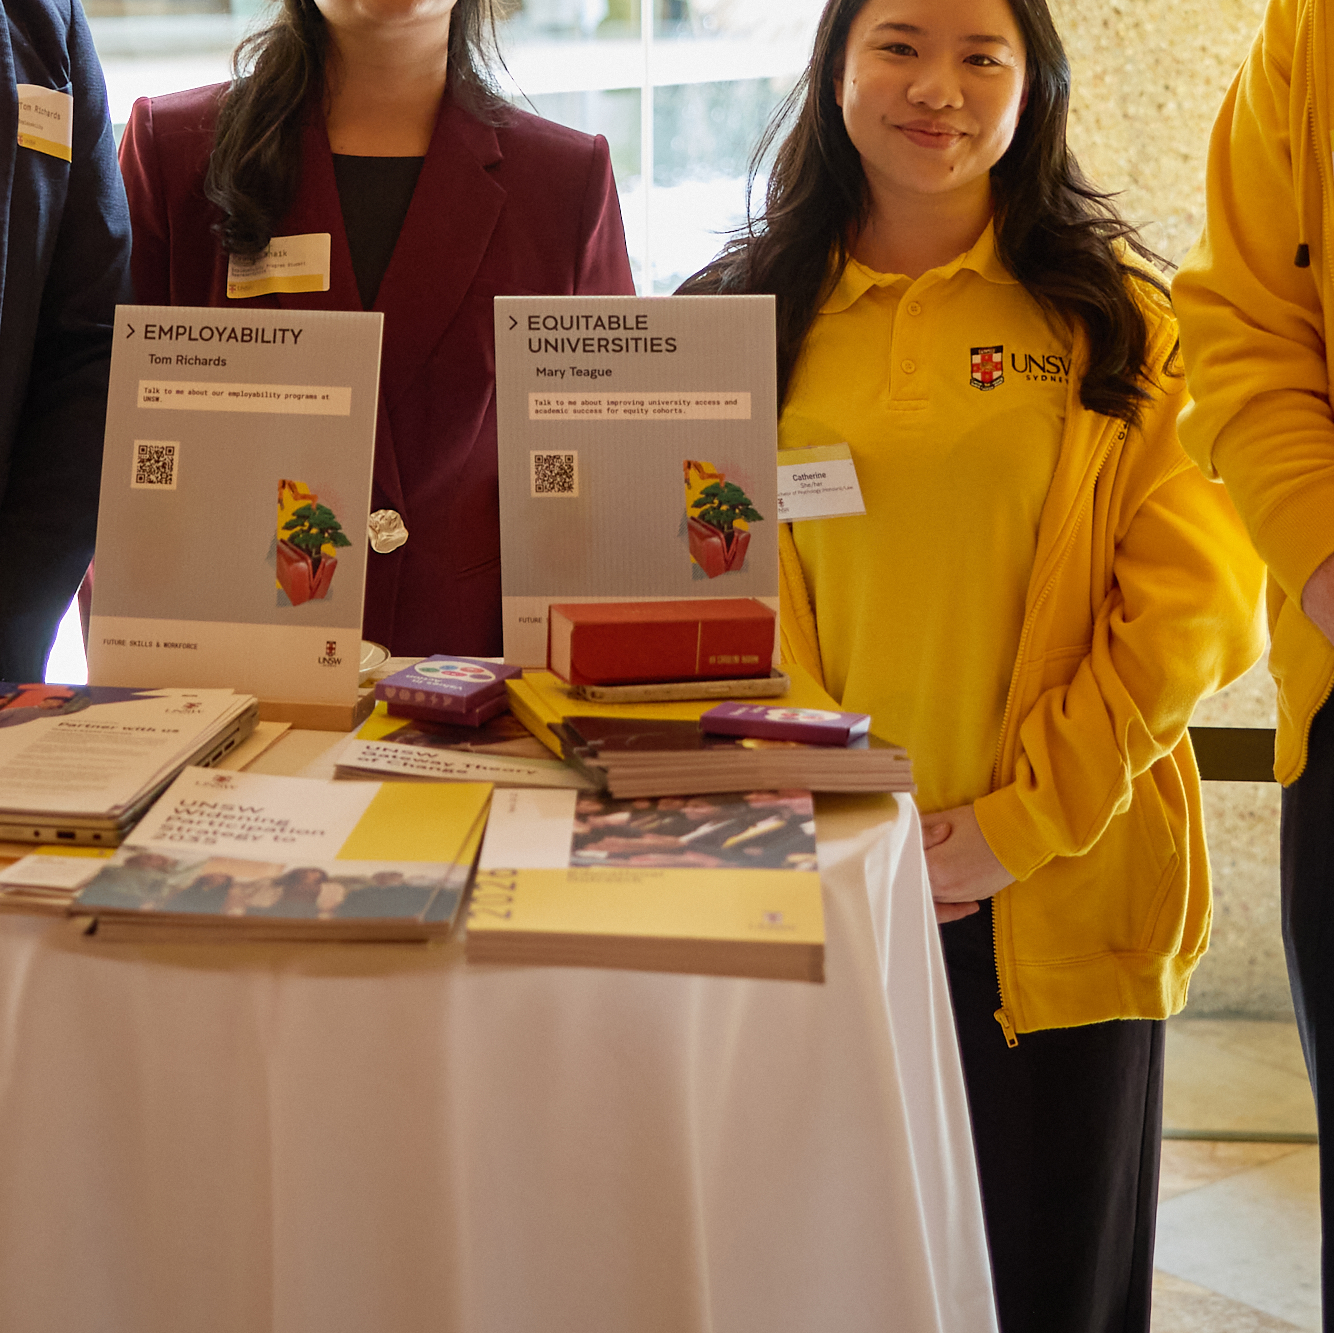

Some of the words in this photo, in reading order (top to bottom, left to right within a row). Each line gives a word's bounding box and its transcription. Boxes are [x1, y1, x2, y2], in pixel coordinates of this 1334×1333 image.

[18, 102, 31, 111] Tom
[35, 105, 61, 120] Richards
[528, 315, 648, 331] EQUITABLE
[144, 324, 303, 345] EMPLOYABILITY
[528, 337, 677, 353] UNIVERSITIES
[148, 354, 172, 365] Tom
[176, 355, 227, 367] Richards
[536, 367, 566, 379] Mary
[569, 366, 613, 379] Teague
[228, 391, 281, 400] employability
[284, 393, 318, 401] programs
[606, 399, 645, 408] improving
[648, 399, 691, 408] university
[623, 408, 649, 416] equity
[793, 472, 826, 481] Catherine
[103, 639, 126, 647] FUTURE
[129, 640, 153, 648] SKILLS
[163, 642, 198, 650] WORKFORCE
[318, 657, 342, 665] UNSW
[366, 745, 439, 758] UNSW
[362, 751, 455, 767] Gateway
[464, 764, 537, 775] Theory
[387, 760, 467, 773] Change
[180, 799, 265, 814] UNSW
[174, 808, 290, 826] Widening
[167, 816, 325, 835] Participation
[161, 824, 263, 841] Strategy
[272, 835, 296, 843] to
